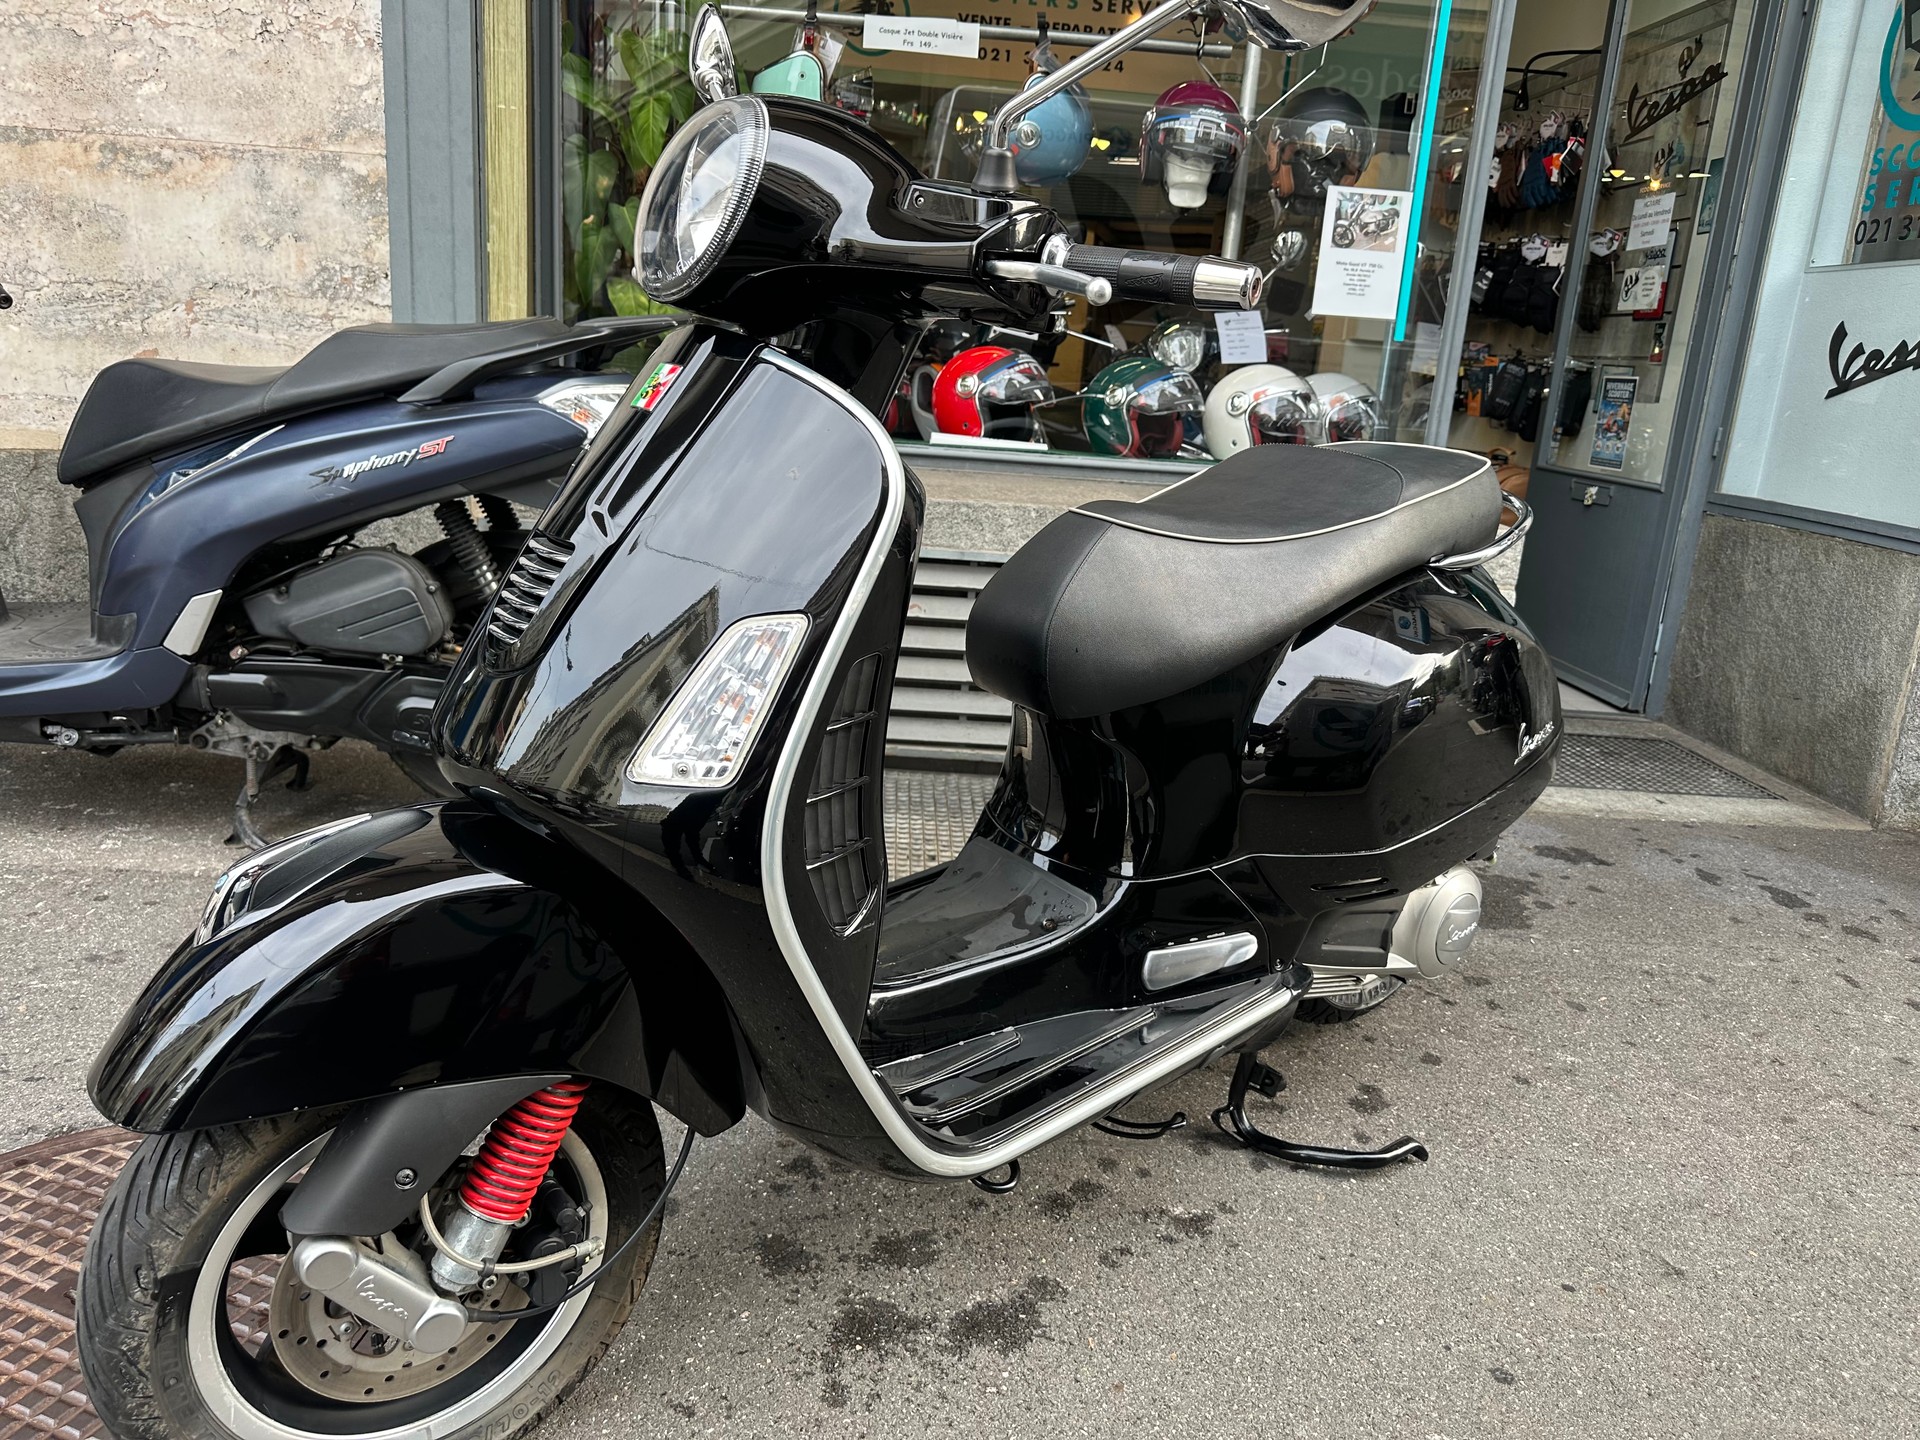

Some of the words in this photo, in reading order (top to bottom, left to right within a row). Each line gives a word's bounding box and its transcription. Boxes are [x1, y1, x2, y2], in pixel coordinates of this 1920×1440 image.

[879, 27, 901, 36] Casque
[917, 29, 939, 38] Double
[941, 32, 964, 41] Visière
[902, 39, 914, 47] Frs
[979, 47, 1011, 63] 021
[1623, 62, 1728, 142] Vespa
[1854, 216, 1892, 245] 021
[416, 434, 455, 460] ST
[356, 1274, 409, 1320] Vespa
